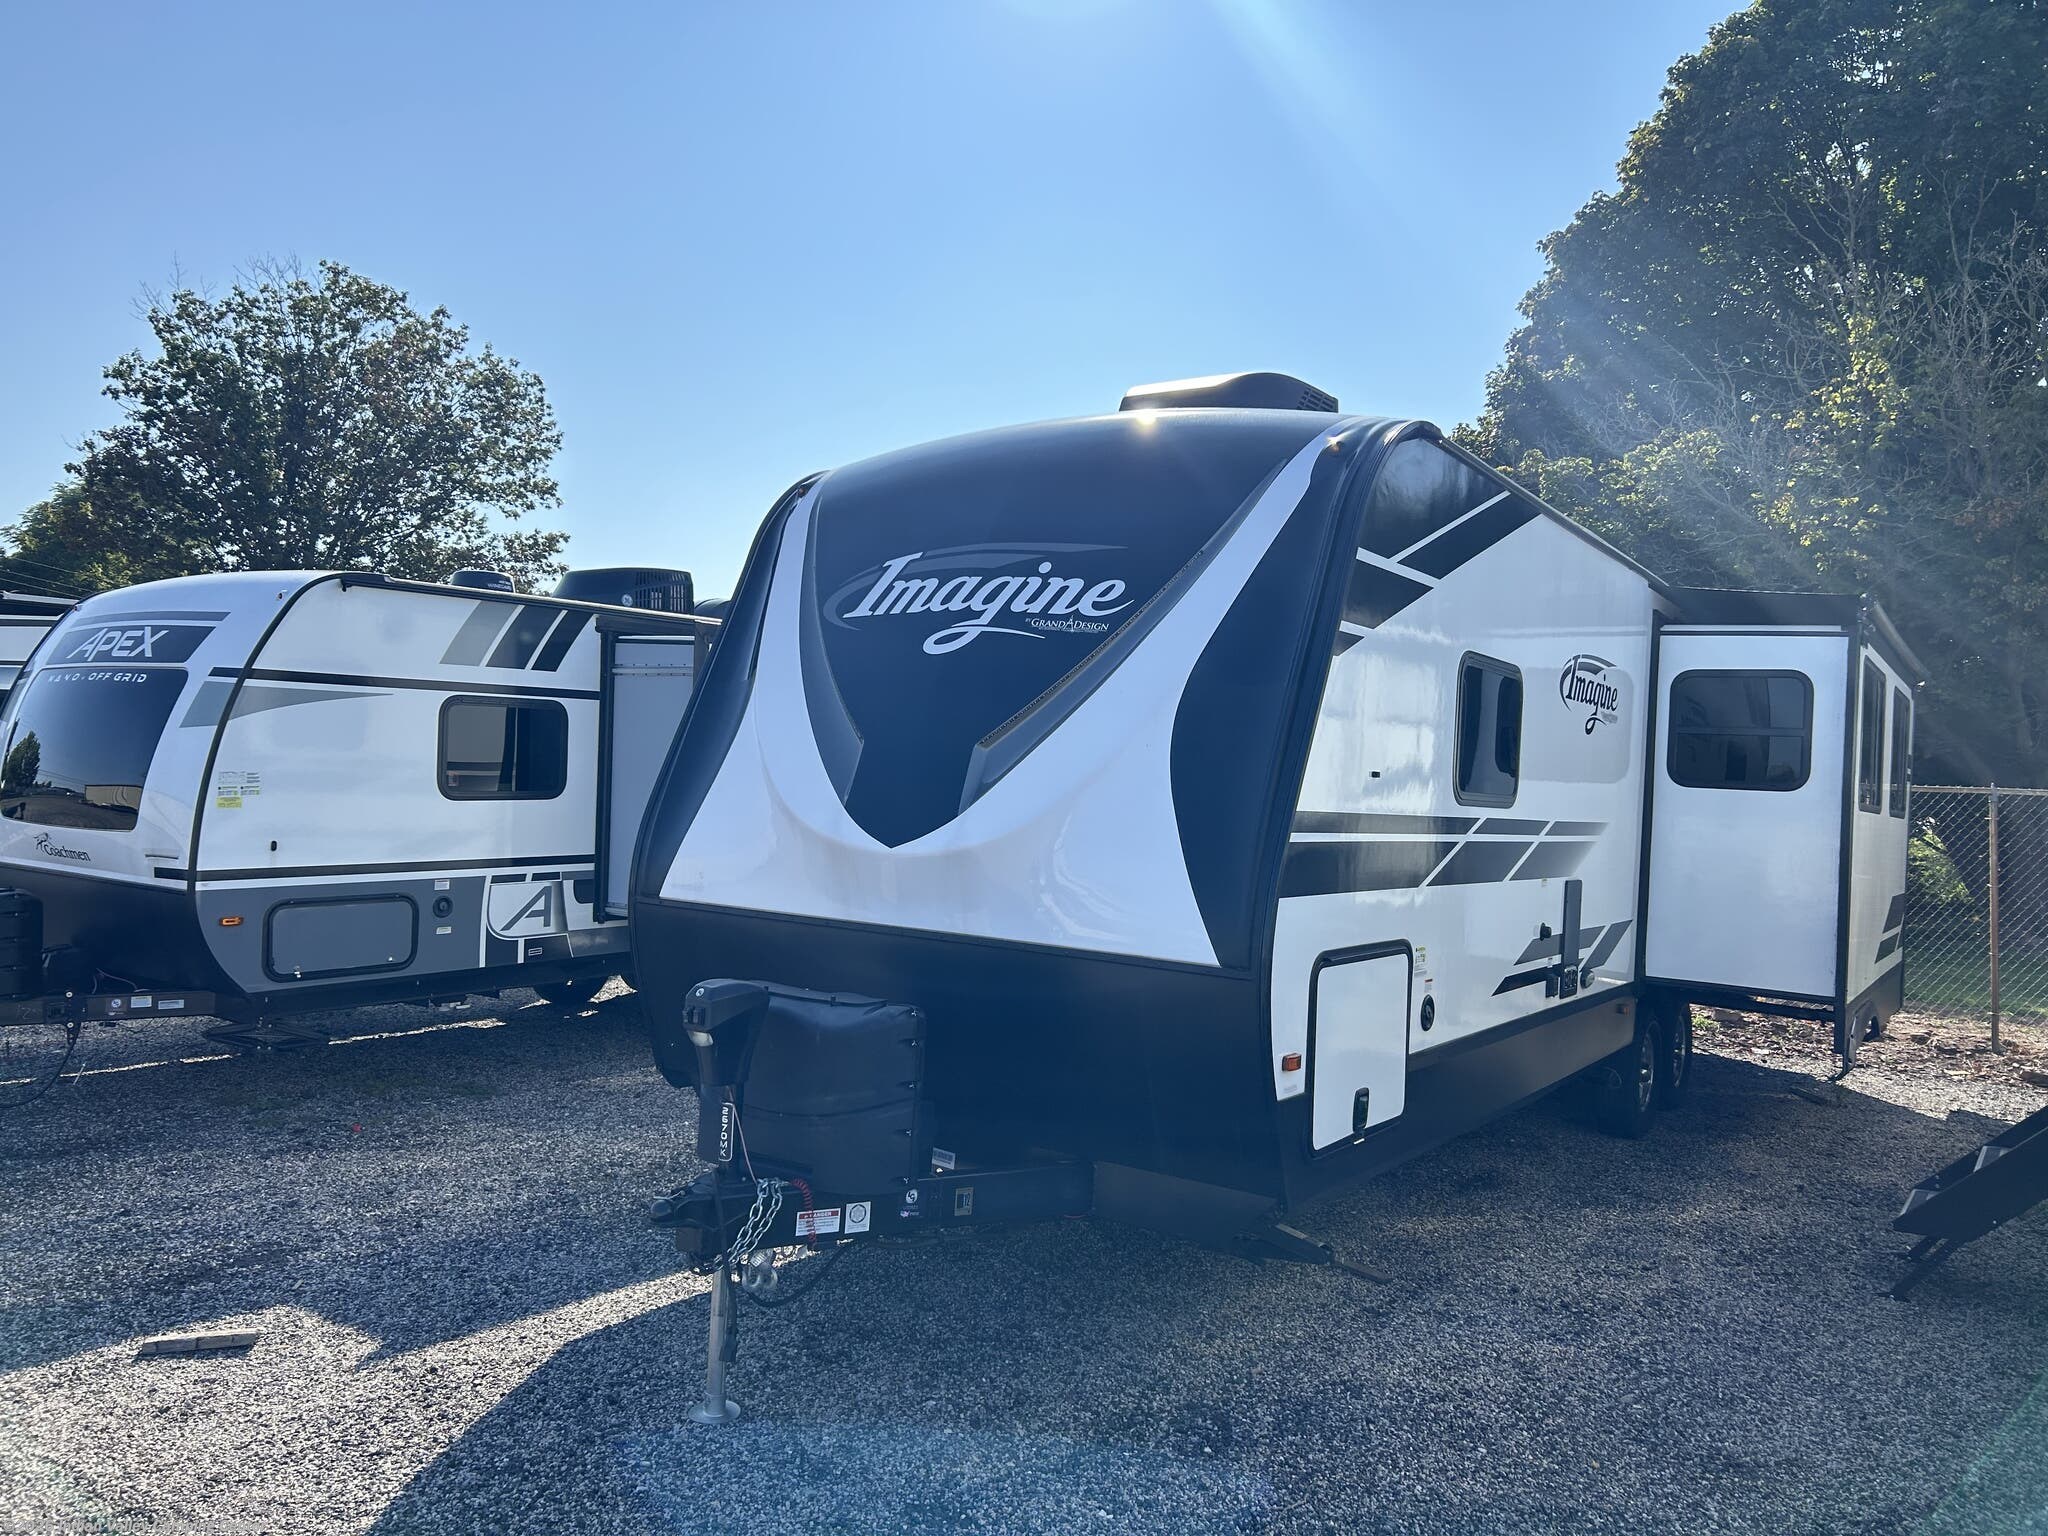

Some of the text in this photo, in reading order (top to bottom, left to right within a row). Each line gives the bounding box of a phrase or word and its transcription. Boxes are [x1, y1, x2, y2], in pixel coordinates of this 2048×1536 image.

[843, 551, 1135, 655] Imagine
[1031, 618, 1066, 629] GRAND
[1074, 620, 1110, 631] DESIGN
[66, 626, 169, 661] APEX
[113, 672, 147, 683] GRID
[1565, 655, 1619, 735] Imagine
[43, 844, 91, 862] Coachmen
[719, 1106, 729, 1157] 2670MK
